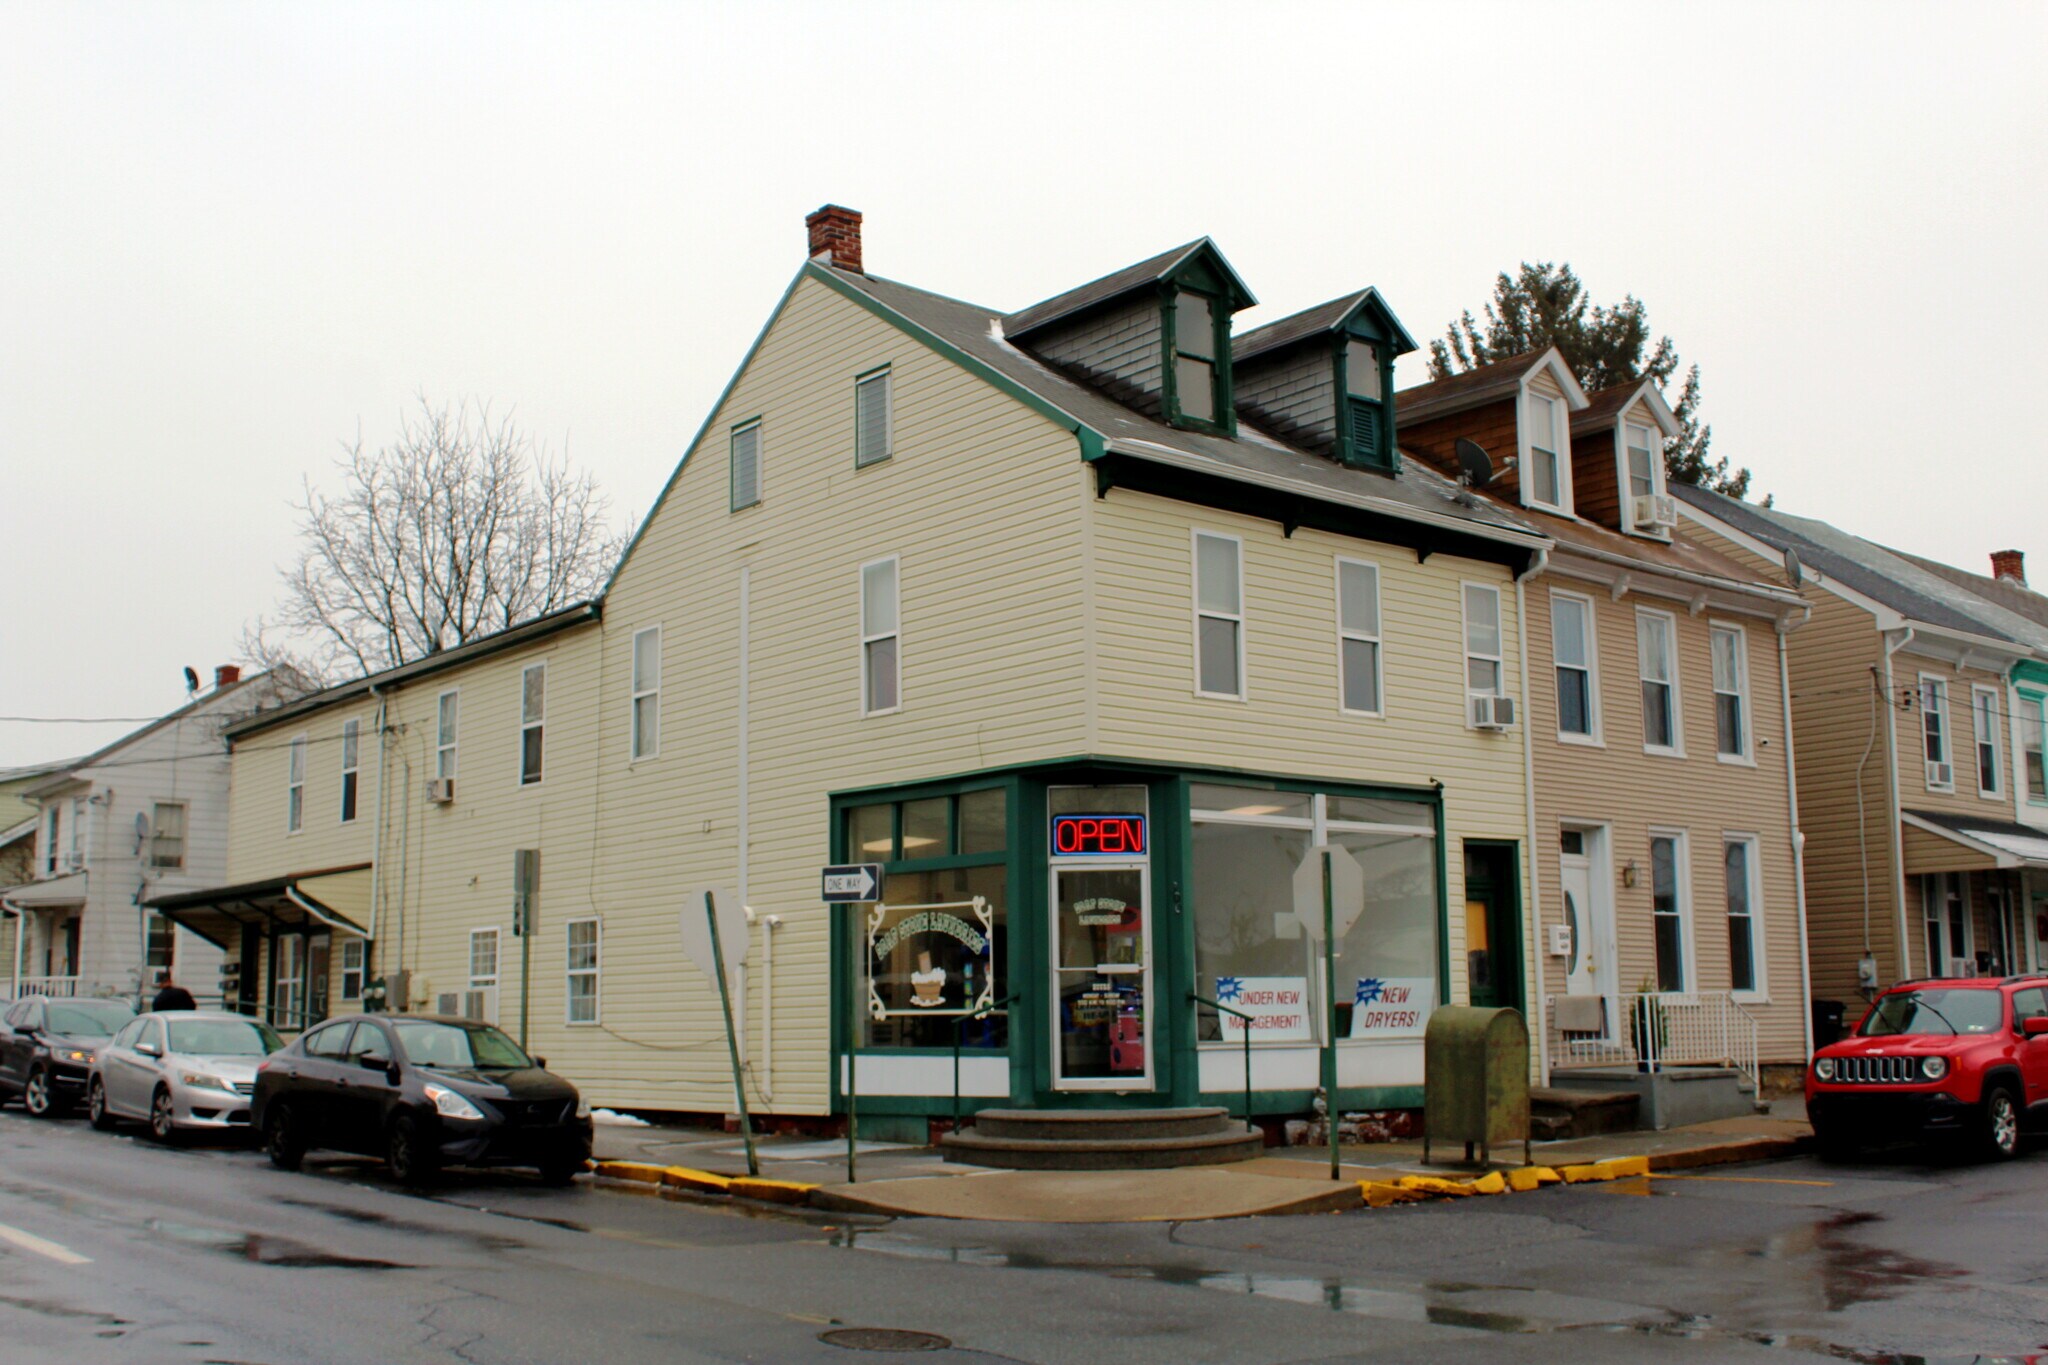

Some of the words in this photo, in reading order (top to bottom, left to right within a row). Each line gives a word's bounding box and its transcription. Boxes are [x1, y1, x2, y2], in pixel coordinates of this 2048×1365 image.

[1057, 819, 1142, 852] OPEN
[828, 878, 842, 890] ONE
[846, 877, 861, 890] WAY
[874, 926, 899, 960] SOAP
[1239, 990, 1274, 1005] UNDER
[1276, 990, 1301, 1005] NEW
[1380, 986, 1412, 1004] NEW
[1364, 1010, 1421, 1029] DRYERS!
